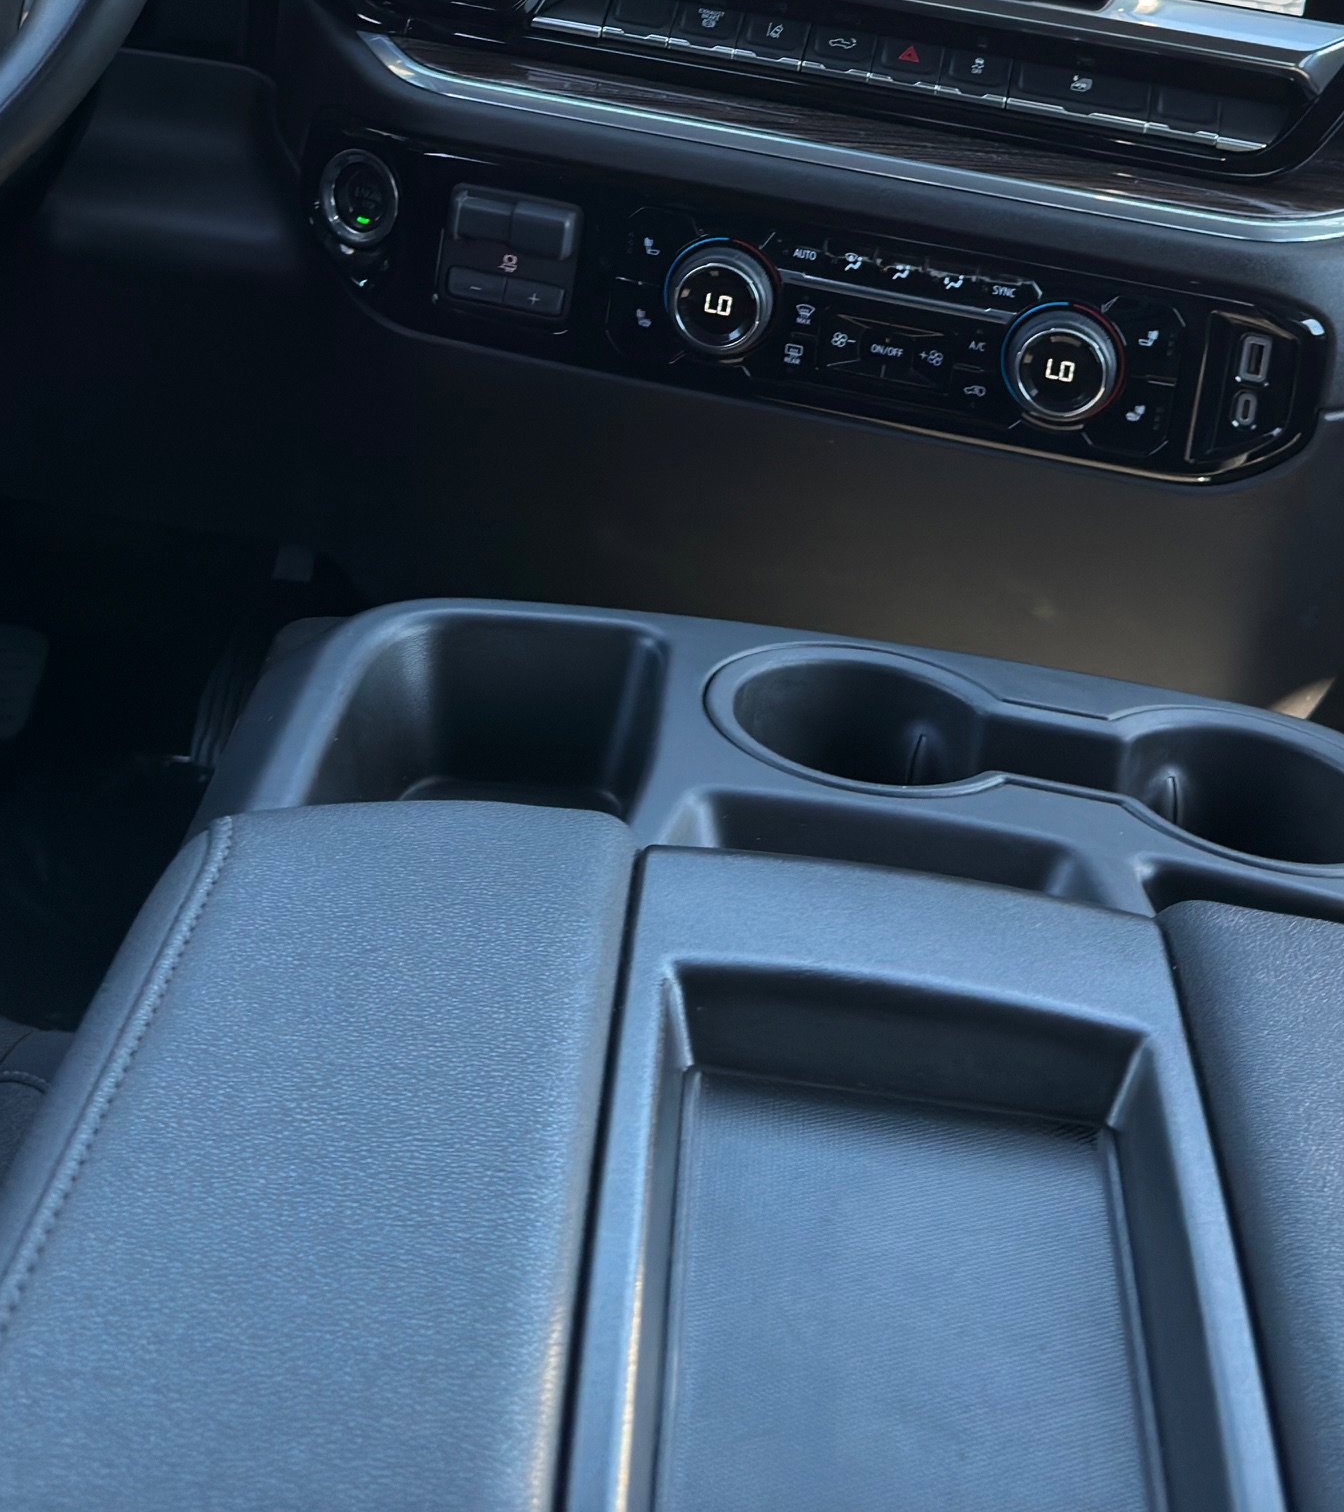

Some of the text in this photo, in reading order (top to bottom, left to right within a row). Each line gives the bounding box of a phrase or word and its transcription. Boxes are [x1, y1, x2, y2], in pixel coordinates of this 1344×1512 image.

[793, 248, 817, 261] AUTO
[992, 285, 1016, 299] SYNC
[704, 292, 733, 317] LO
[796, 317, 811, 326] MAX
[870, 343, 903, 358] ON/OFF
[969, 340, 986, 353] A/C
[784, 355, 801, 366] REAR
[1045, 358, 1075, 382] LO
